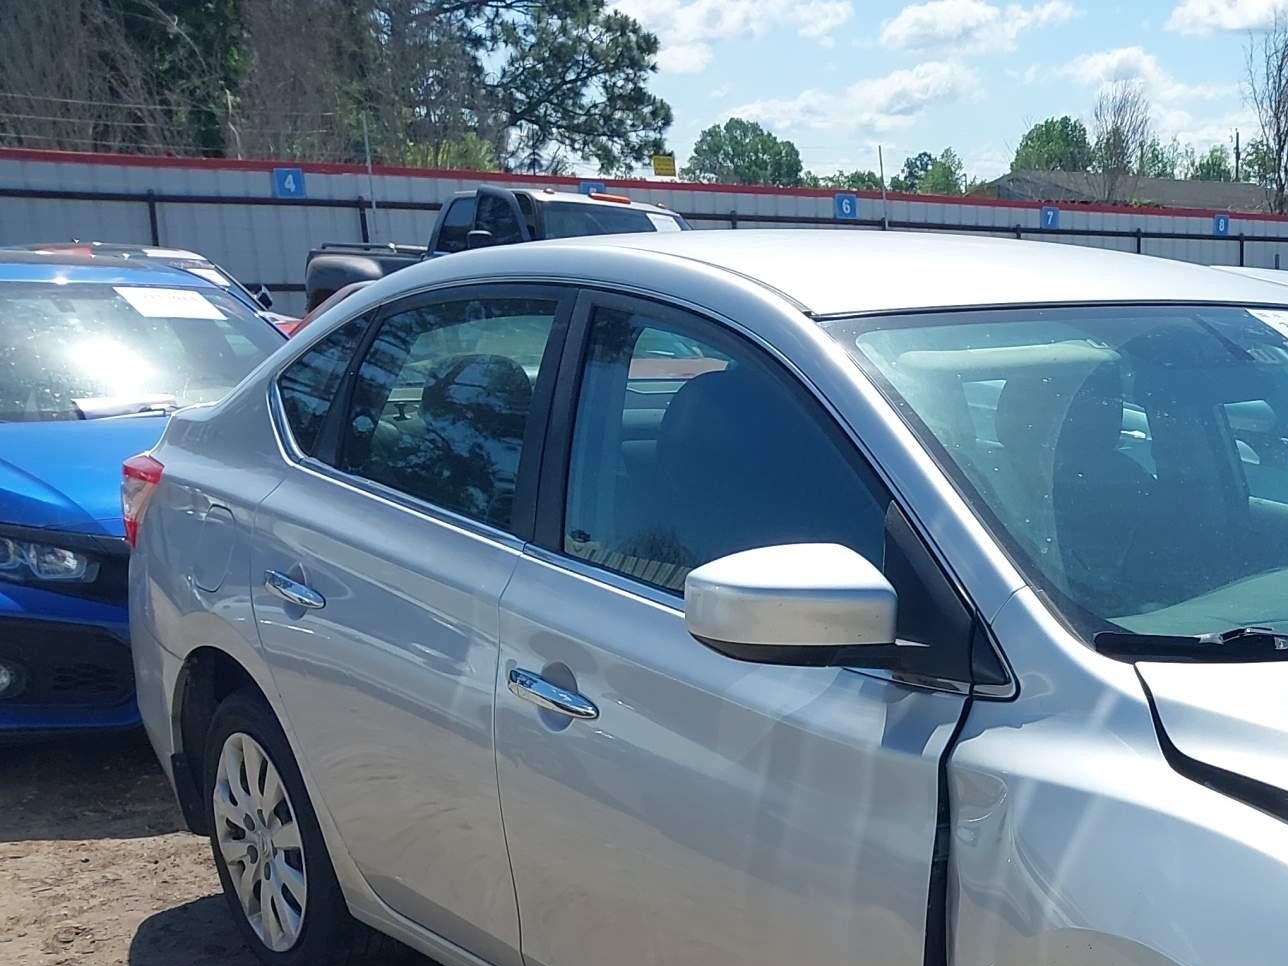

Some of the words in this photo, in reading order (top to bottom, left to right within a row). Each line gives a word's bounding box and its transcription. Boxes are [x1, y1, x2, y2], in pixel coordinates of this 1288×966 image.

[284, 174, 296, 193] 4
[842, 199, 851, 214] 6
[1047, 210, 1054, 225] 7
[1218, 218, 1225, 231] 8
